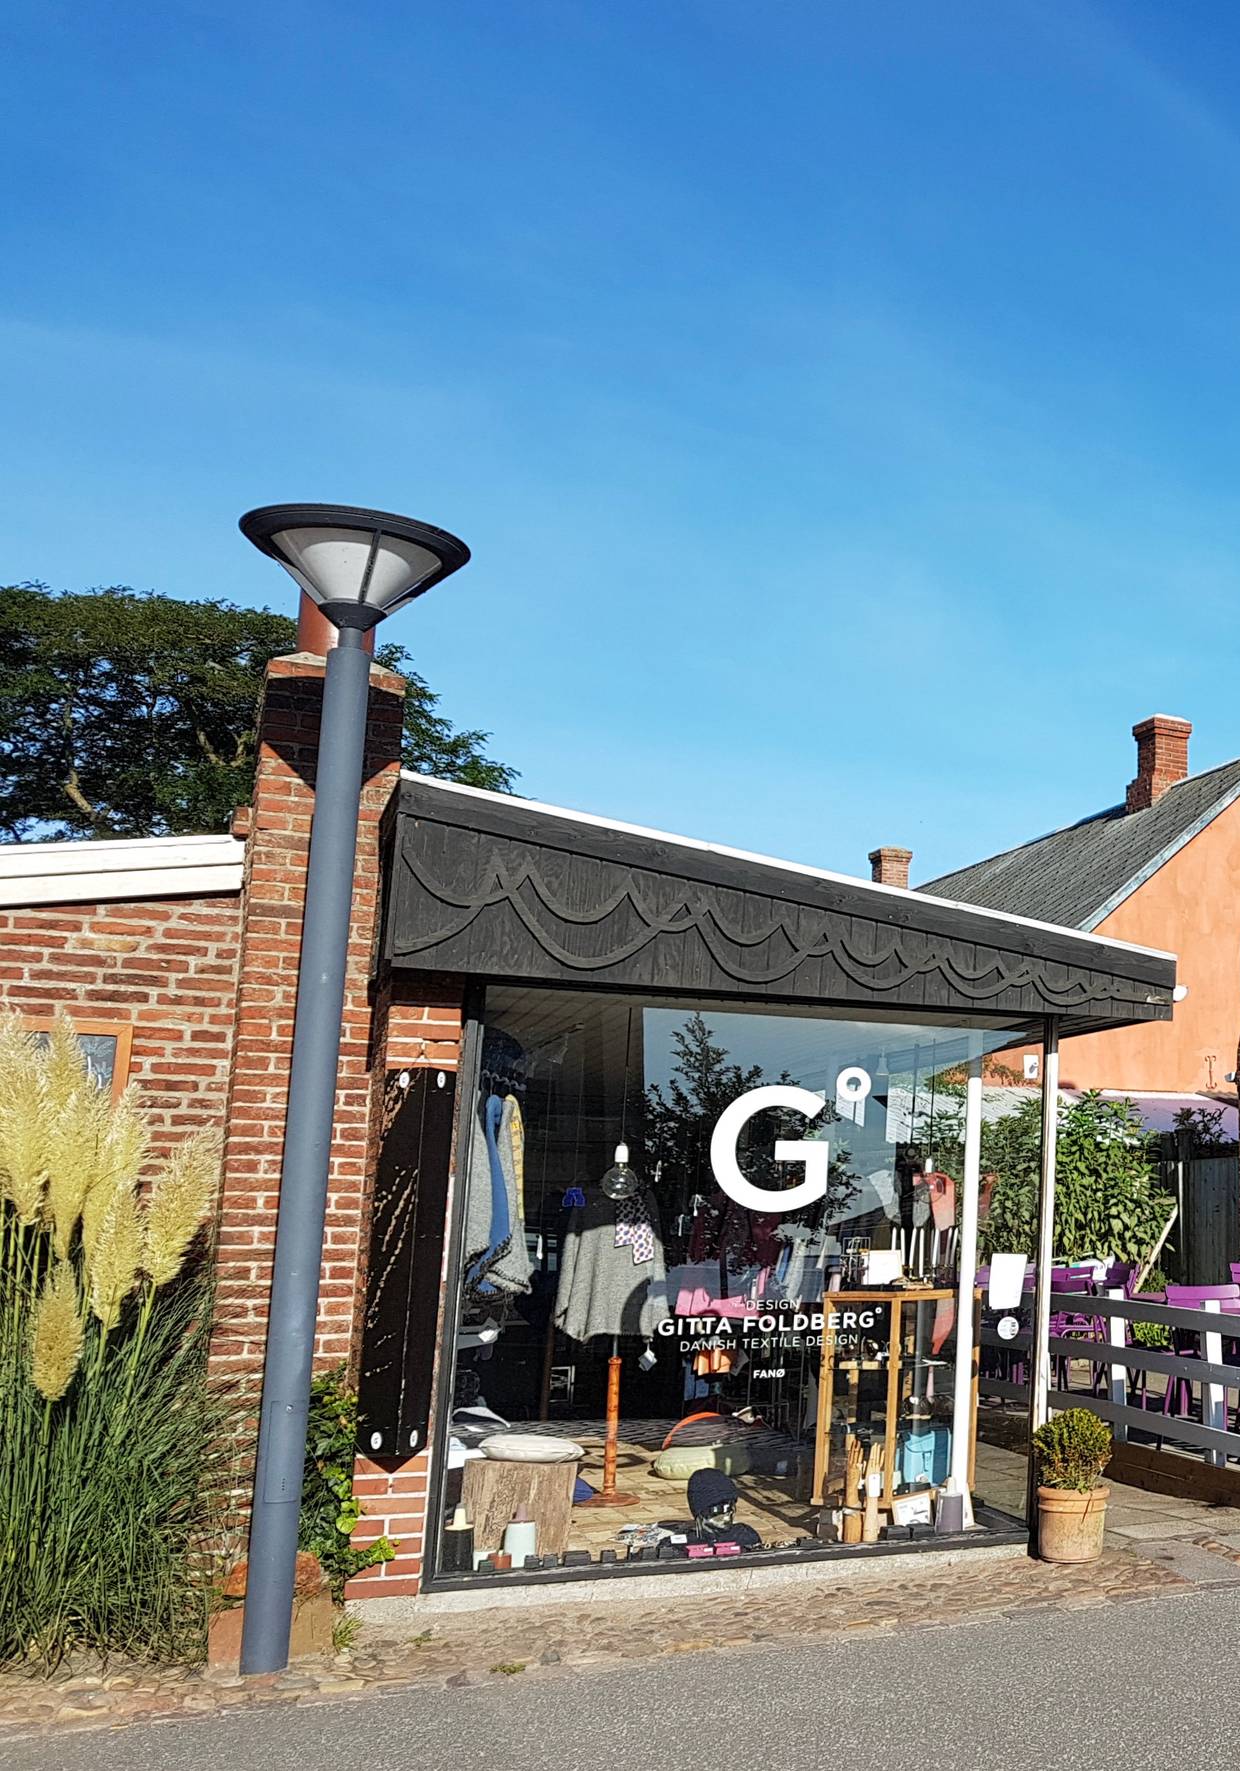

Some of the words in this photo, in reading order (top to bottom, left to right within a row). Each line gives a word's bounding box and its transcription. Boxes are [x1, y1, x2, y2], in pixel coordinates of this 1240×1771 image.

[746, 1299, 800, 1312] DESIGN
[658, 1317, 733, 1337] GITTA
[680, 1339, 736, 1352] DANISH
[742, 1336, 801, 1350] TEXTILE
[806, 1334, 859, 1347] DESIGN
[753, 1368, 786, 1379] FANØ
